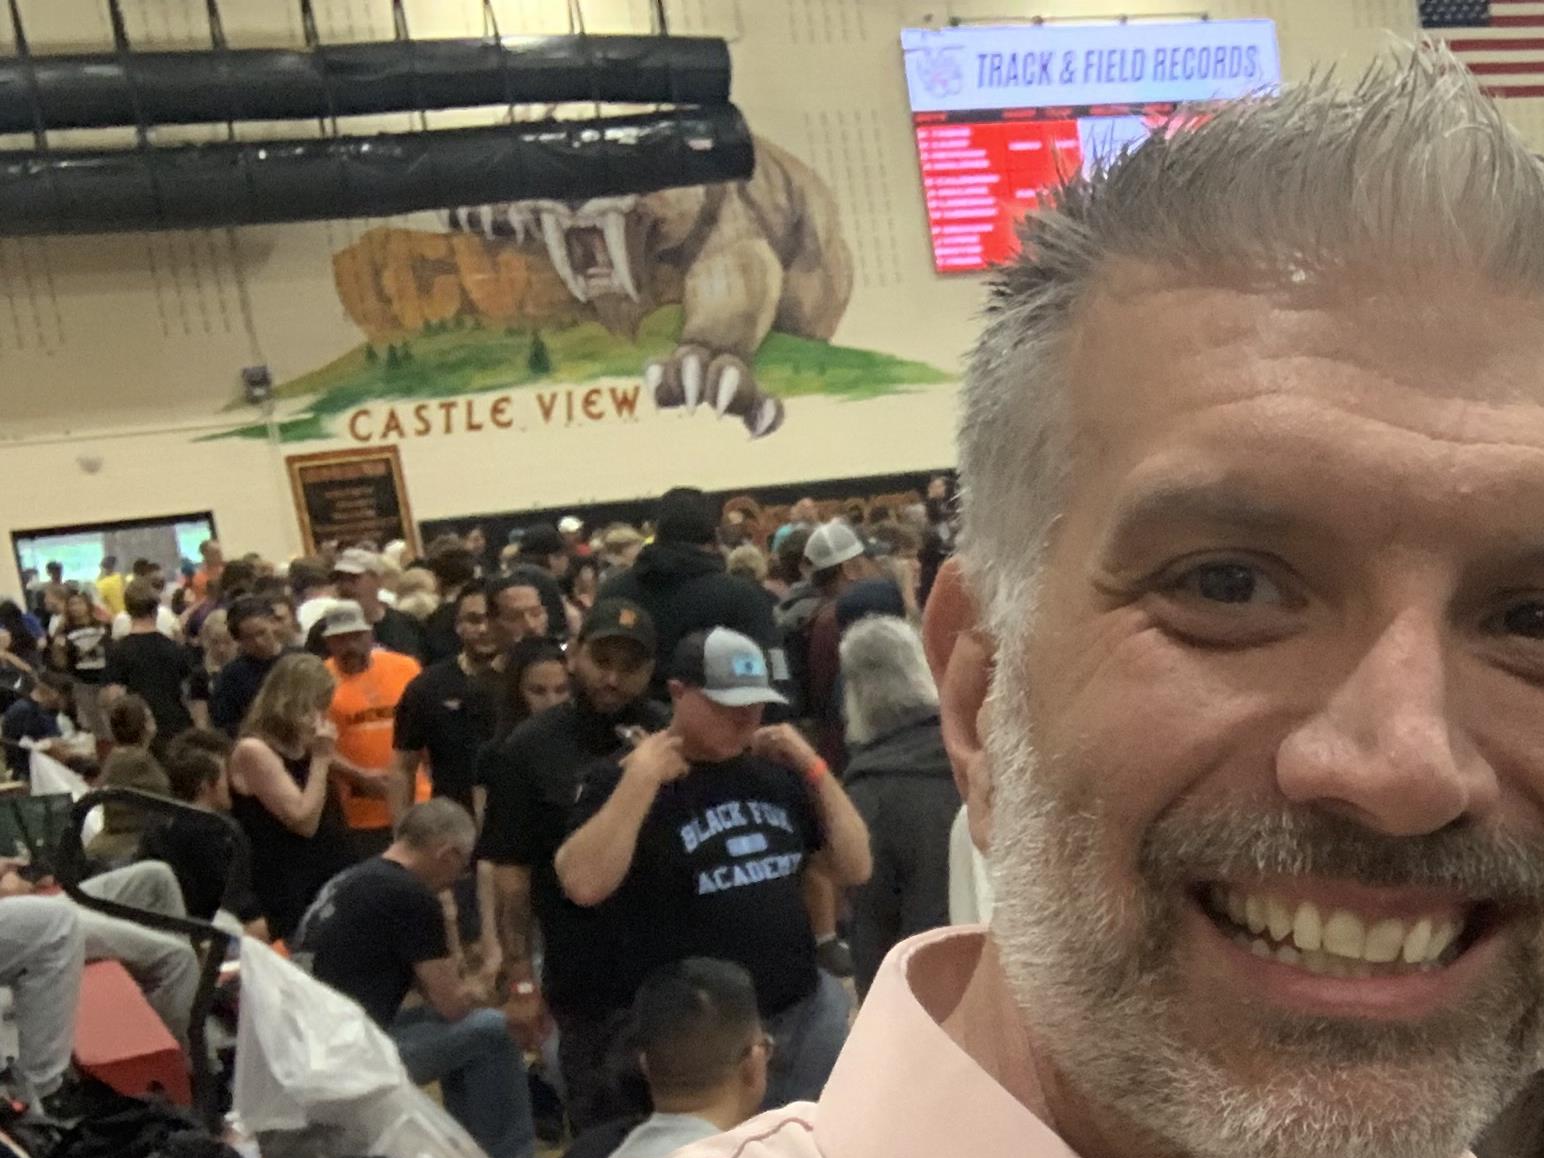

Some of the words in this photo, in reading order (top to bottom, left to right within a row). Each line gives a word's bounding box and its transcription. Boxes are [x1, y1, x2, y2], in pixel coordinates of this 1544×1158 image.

[977, 51, 1053, 88] TRACK
[1059, 50, 1076, 84] &
[1083, 48, 1146, 84] FIELD
[1152, 45, 1258, 82] RECORDS
[349, 396, 514, 442] CASTLE
[536, 385, 641, 423] VIEW
[681, 801, 748, 853] BLACK
[699, 853, 802, 894] ACADEMY
